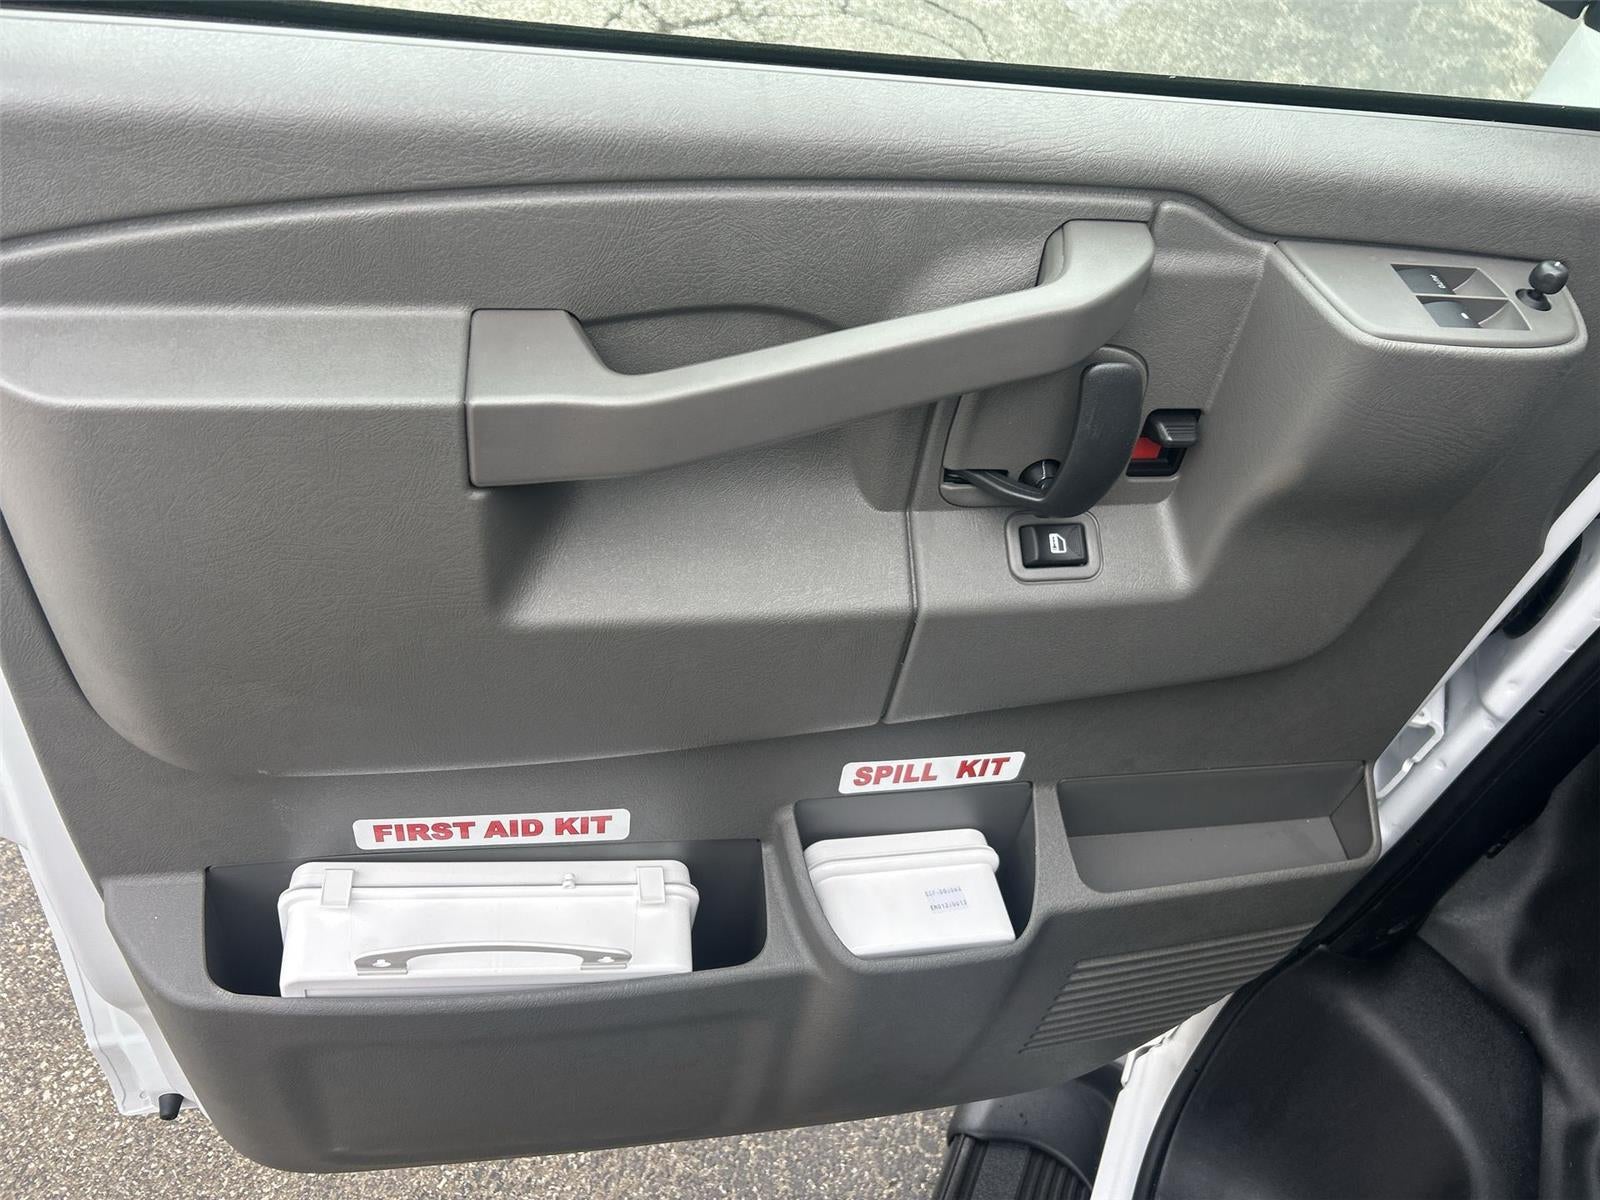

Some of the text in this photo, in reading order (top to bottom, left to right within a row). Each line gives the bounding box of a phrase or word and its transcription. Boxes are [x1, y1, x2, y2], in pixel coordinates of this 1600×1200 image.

[853, 757, 1011, 787] SPILL KIT
[373, 815, 613, 842] FIRST AID KIT
